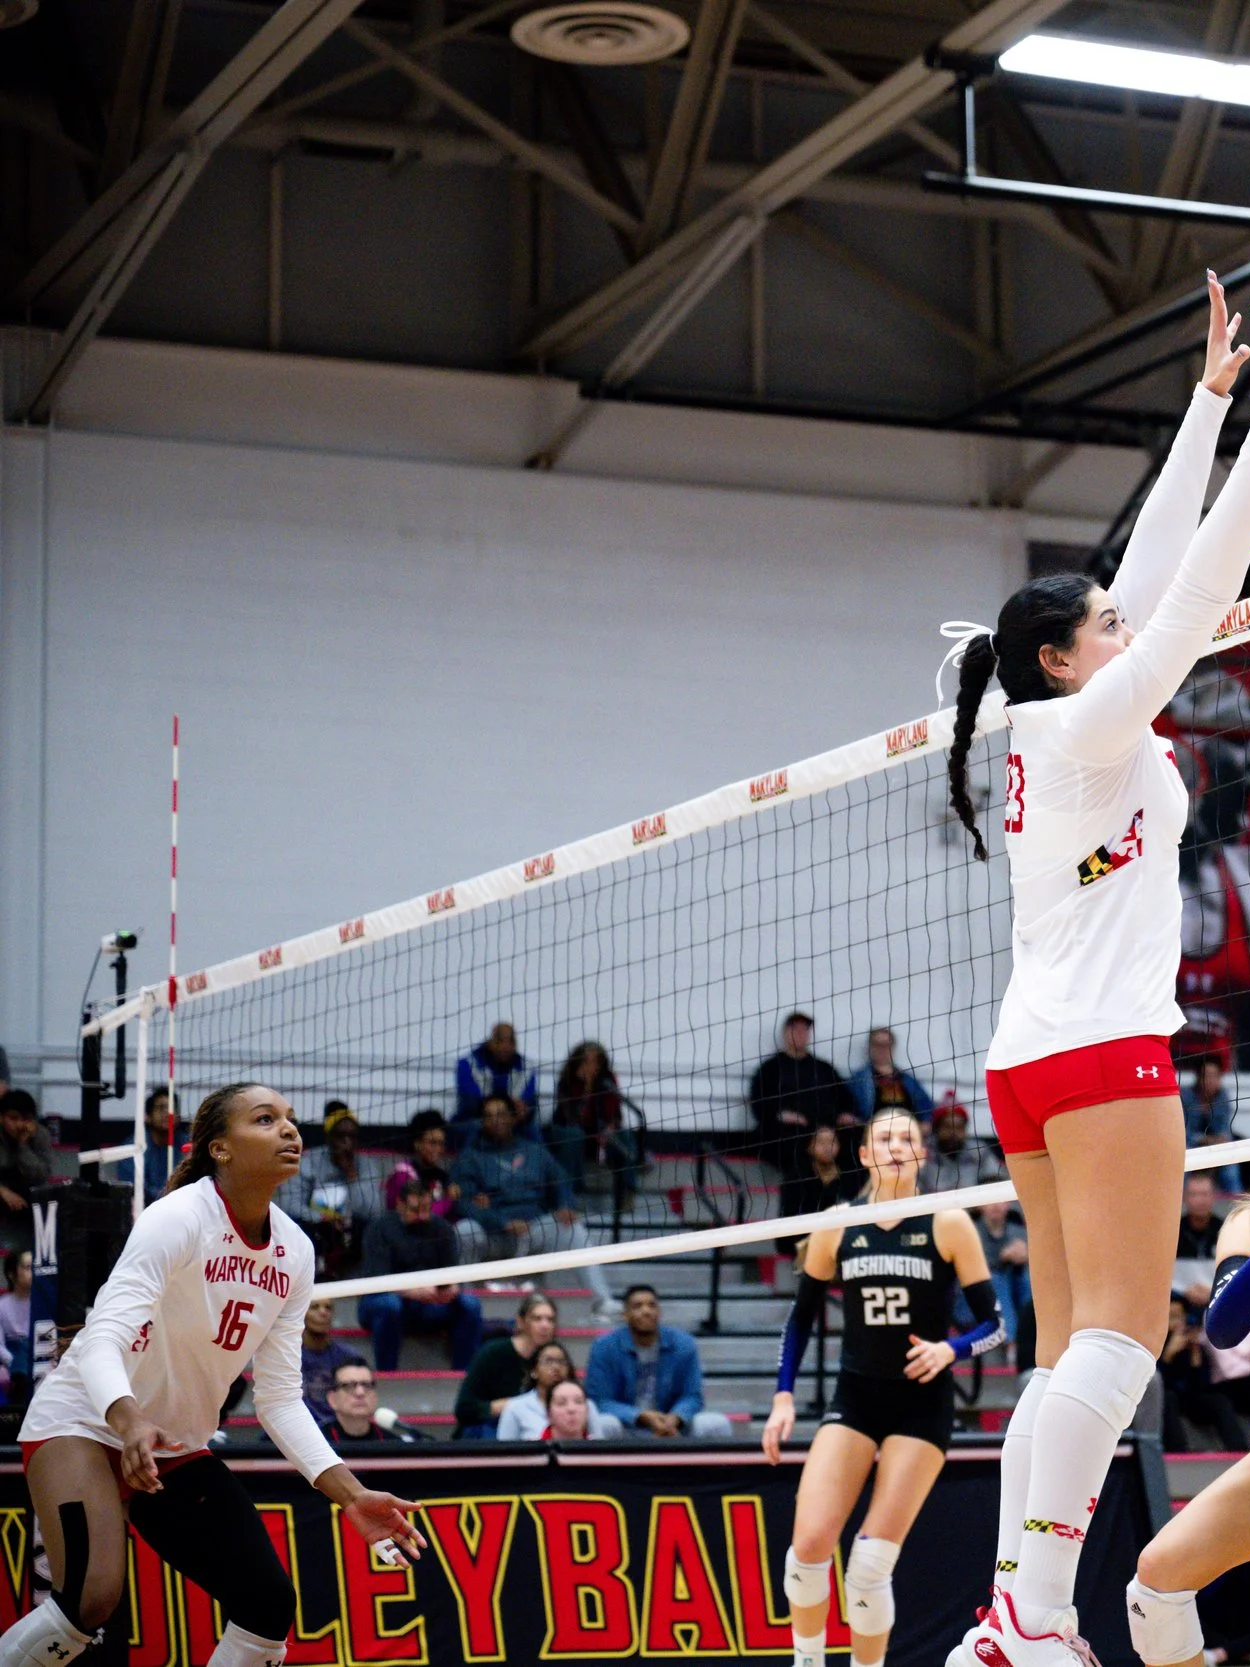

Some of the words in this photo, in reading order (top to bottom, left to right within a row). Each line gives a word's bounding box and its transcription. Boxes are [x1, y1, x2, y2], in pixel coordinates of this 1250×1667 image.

[32, 1201, 59, 1267] M
[204, 1255, 290, 1299] MARYLAND
[841, 1254, 933, 1282] WASHINGTON
[212, 1299, 255, 1352] 16
[861, 1287, 911, 1326] 22
